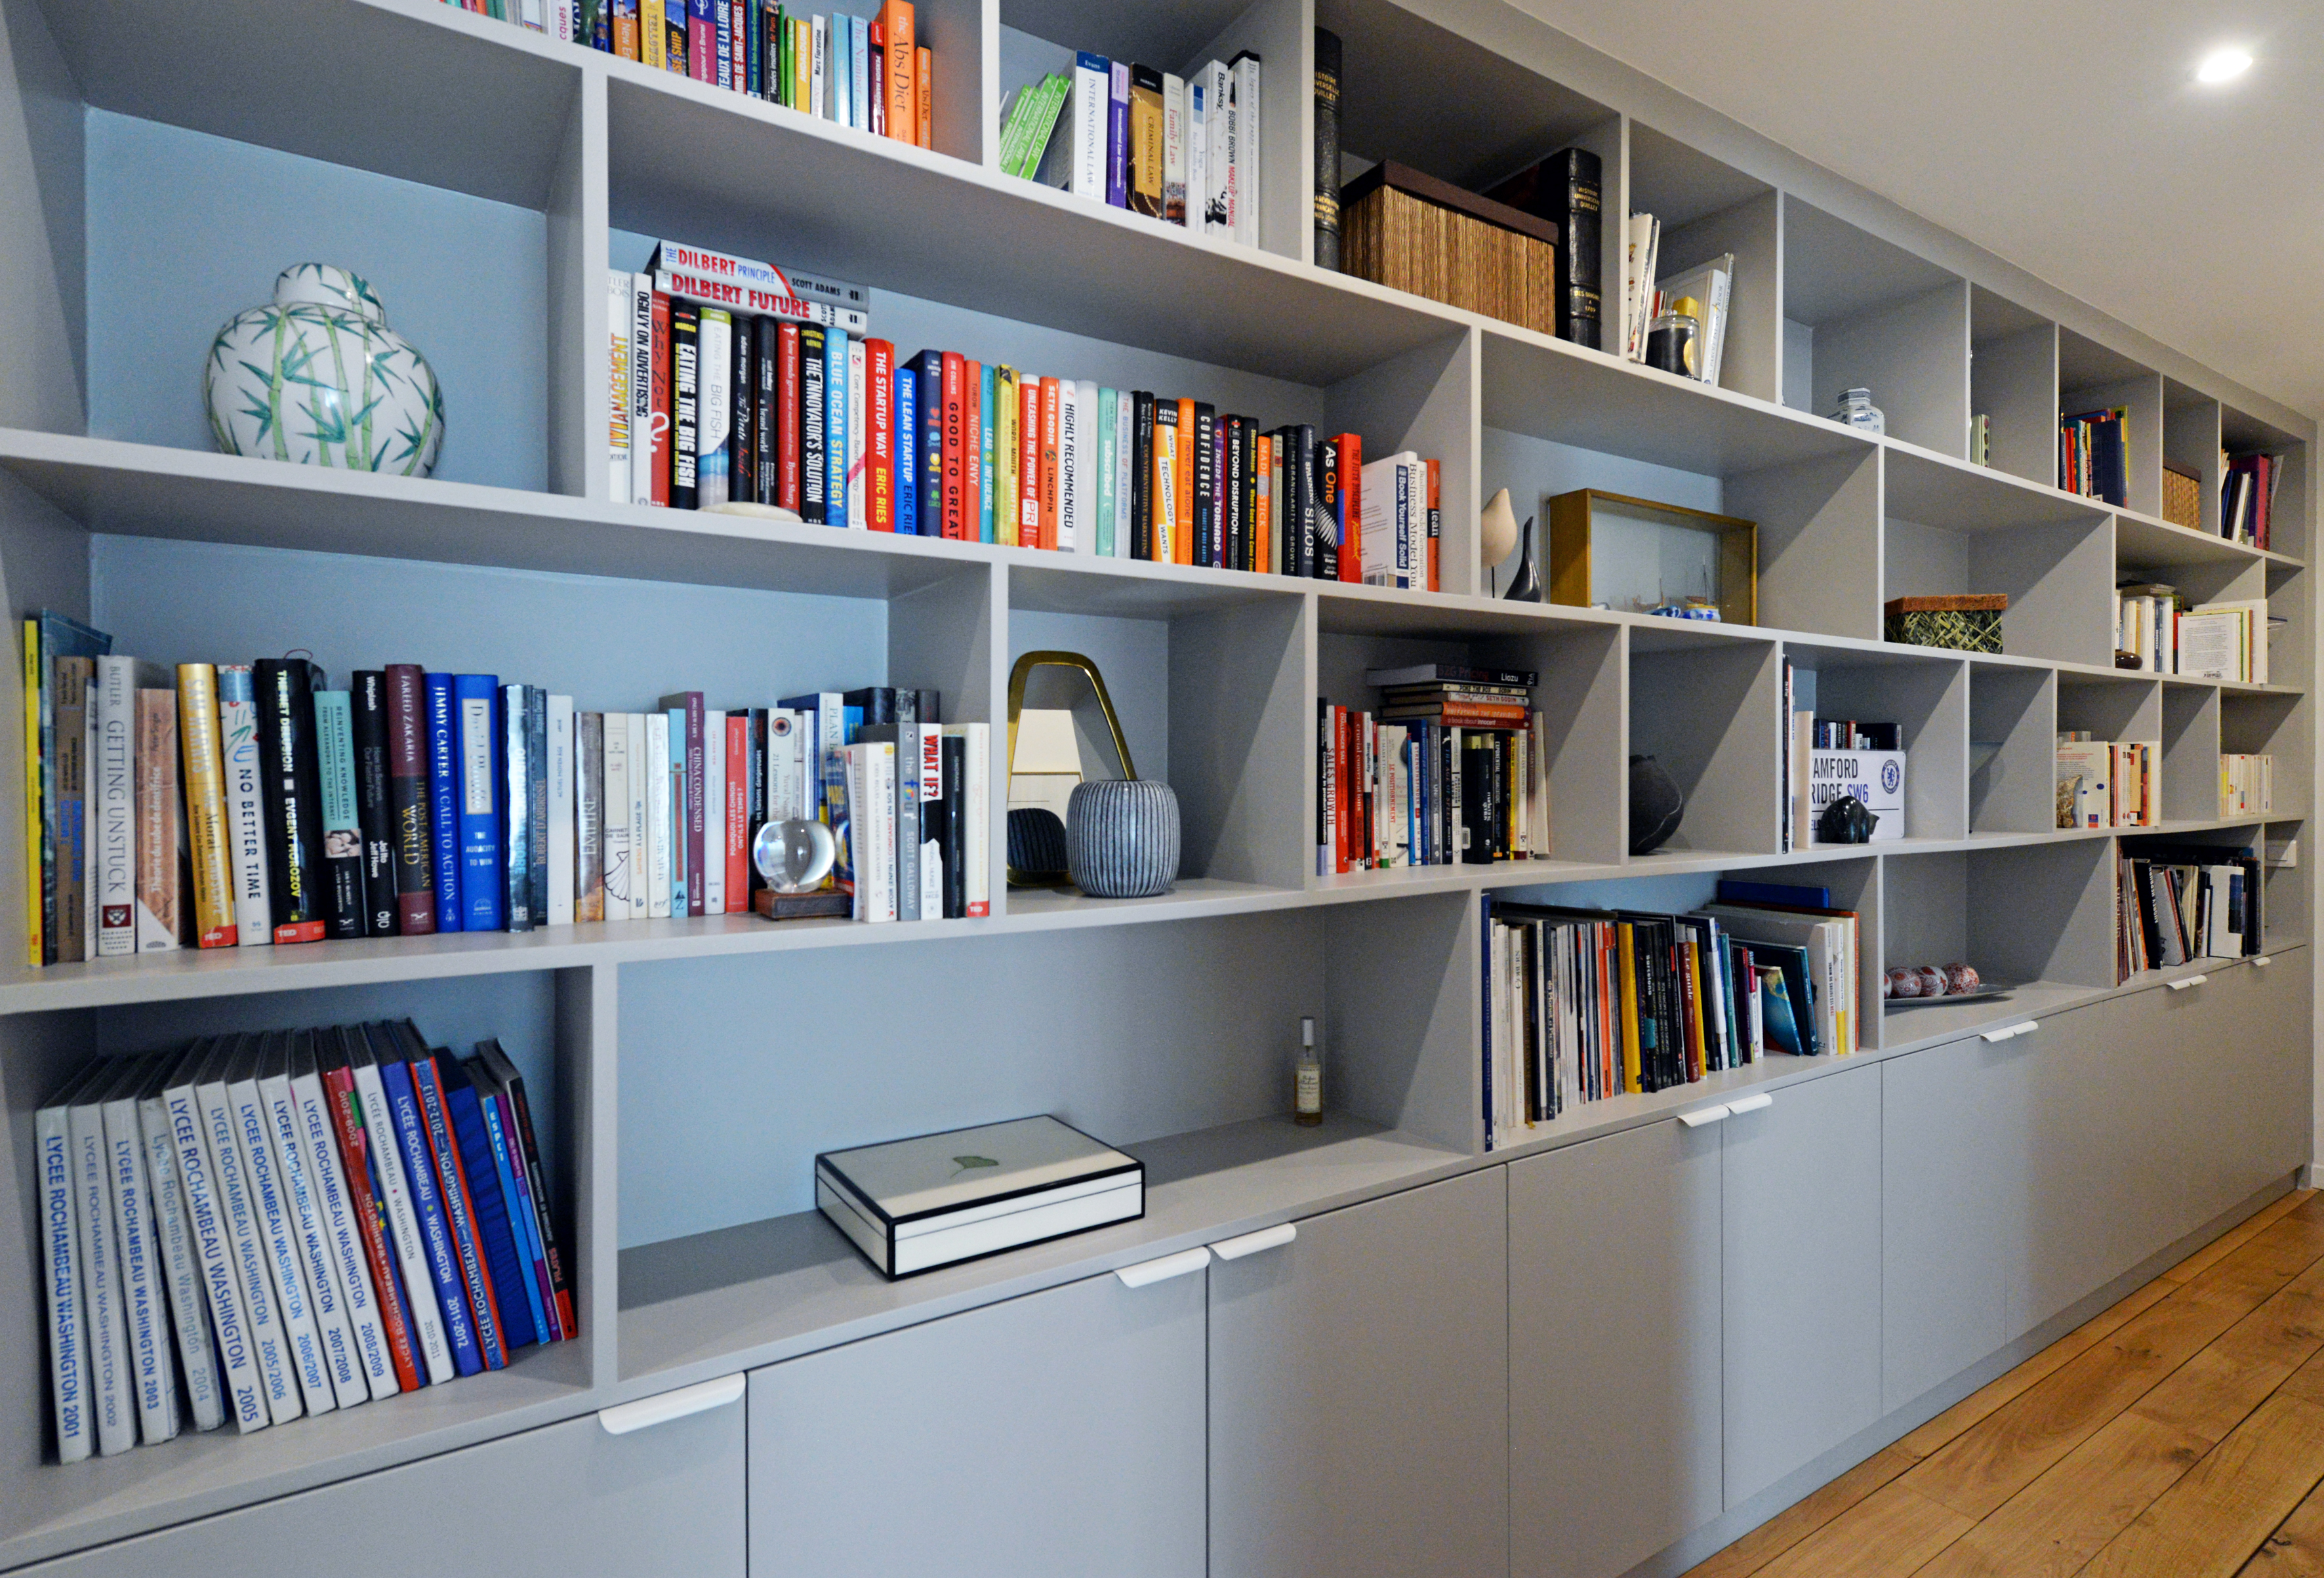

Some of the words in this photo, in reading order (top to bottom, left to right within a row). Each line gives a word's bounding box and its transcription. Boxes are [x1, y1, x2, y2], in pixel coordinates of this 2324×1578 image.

[734, 5, 744, 60] SAINT-JACQUES
[769, 33, 776, 42] de
[899, 16, 909, 35] the
[734, 62, 744, 73] DE
[894, 33, 909, 70] Abs
[1085, 60, 1101, 70] Evans
[734, 74, 744, 94] MINS
[1315, 71, 1337, 85] ISTOIRE
[1087, 78, 1096, 163] INTERNATIONAL
[1087, 166, 1095, 186] LAW
[666, 247, 677, 263] THE
[678, 249, 736, 277] DILBERT
[738, 264, 776, 284] PRINCIPLE
[792, 277, 813, 290] SCOTT
[815, 283, 841, 296] ADAMS
[636, 291, 650, 329] OGILVY
[672, 273, 743, 304] DILBERT
[748, 289, 810, 319] FUTURE
[636, 331, 649, 343] ON
[679, 343, 696, 394] EATING
[806, 357, 823, 380] THE
[831, 351, 843, 386] BLUE
[876, 352, 886, 373] THE
[678, 397, 696, 424] THE
[805, 382, 823, 451] INNOVATOR'S
[830, 390, 843, 435] OCEAN
[876, 374, 887, 430] STARTUP
[1027, 389, 1036, 438] UNLEASHING
[1158, 408, 1178, 418] KEVIN
[1158, 415, 1177, 424] KELLY
[678, 426, 695, 453] BIG
[948, 402, 959, 447] GOOD
[969, 415, 979, 451] NICHE
[1064, 403, 1075, 443] HIGHLY
[876, 432, 886, 458] WAY
[1027, 439, 1036, 453] THE
[1200, 415, 1211, 498] CONFIDENCE
[1231, 439, 1240, 479] BEYOND
[1325, 446, 1336, 468] As
[678, 455, 695, 488] FISH
[806, 451, 823, 503] SOLUTION
[830, 439, 843, 509] STRATEGY
[876, 468, 886, 495] ERIC
[948, 456, 958, 477] TO
[969, 455, 979, 487] ENVY
[1027, 455, 1036, 485] POWER
[1063, 443, 1074, 529] RECOMMENDED
[1103, 439, 1114, 496] subscribed
[1305, 460, 1314, 505] SPANNING
[1027, 487, 1036, 498] OF
[1161, 460, 1175, 524] TECHNOLOGY
[1231, 480, 1240, 535] DISRUPTION
[1325, 471, 1337, 504] One
[1398, 476, 1407, 501] Book
[876, 497, 887, 523] RIES
[948, 485, 959, 539] GREAT
[1025, 501, 1035, 523] PR
[1213, 500, 1222, 552] TORNADO
[1398, 502, 1408, 543] Yourself
[1431, 510, 1439, 536] lean
[1160, 526, 1169, 555] WANTS
[1304, 507, 1314, 557] SILOS
[1398, 544, 1408, 568] Solid
[109, 665, 121, 707] BUTLER
[365, 676, 378, 712] Whiplash
[400, 675, 414, 713] FAREED
[1501, 673, 1519, 682] Liozu
[434, 686, 448, 727] JIMMY
[828, 708, 838, 739] PLAN
[335, 706, 346, 764] REINVENTING
[403, 714, 416, 763] ZAKARIA
[436, 729, 450, 779] CARTER
[924, 735, 939, 772] WHAT
[106, 719, 126, 801] GETTING
[693, 746, 702, 775] CHINA
[1326, 748, 1335, 779] SALES
[1813, 758, 1858, 779] AMFORD
[238, 768, 255, 794] NO
[338, 766, 350, 820] KNOWLEDGE
[924, 777, 939, 797] IF?
[1812, 783, 1843, 804] RIDGE
[1847, 783, 1869, 803] SW6
[439, 795, 453, 829] CALL
[693, 777, 703, 832] CONDENSED
[1327, 783, 1335, 825] GROWTH
[241, 800, 258, 857] BETTER
[401, 804, 419, 865] WORLD
[441, 830, 453, 850] TO
[465, 844, 496, 853] AUDACITY
[907, 830, 915, 859] SCOTT
[107, 807, 126, 893] UNSTUCK
[245, 863, 261, 900] TIME
[442, 853, 456, 901] ACTION
[907, 861, 916, 910] GALLOWAY
[277, 929, 297, 938] TED
[210, 1107, 230, 1144] LYCEE
[273, 1099, 295, 1141] LYCEE
[303, 1099, 324, 1140] LYCEE
[46, 1135, 64, 1185] LYCEE
[115, 1140, 134, 1185] LYCEE
[219, 1146, 251, 1238] ROCHAMBEAU
[283, 1142, 316, 1232] ROCHAMBEAU
[313, 1140, 347, 1228] ROCHAMBEAU
[49, 1188, 72, 1297] ROCHAMBEAU
[122, 1188, 145, 1282] ROCHAMBEAU
[240, 1103, 262, 1145] LYCEE
[251, 1146, 285, 1236] ROCHAMBEAU
[273, 1236, 304, 1320] WASHINGTON
[297, 1333, 322, 1389] 2006/2007
[169, 1098, 195, 1144] LYCEE
[182, 1147, 222, 1260] ROCHAMBEAU
[209, 1261, 247, 1370] WASHINGTON
[236, 1385, 259, 1423] 2005
[305, 1231, 336, 1314] WASHINGTON
[336, 1228, 367, 1310] WASHINGTON
[239, 1238, 270, 1326] WASHINGTON
[134, 1284, 155, 1377] WASHINGTON
[360, 1322, 385, 1378] 2008/2009
[56, 1299, 78, 1403] WASHINGTON
[262, 1339, 287, 1401] 2005/2006
[328, 1326, 352, 1384] 2007/2008
[144, 1379, 160, 1410] 2003
[63, 1405, 81, 1438] 2001
